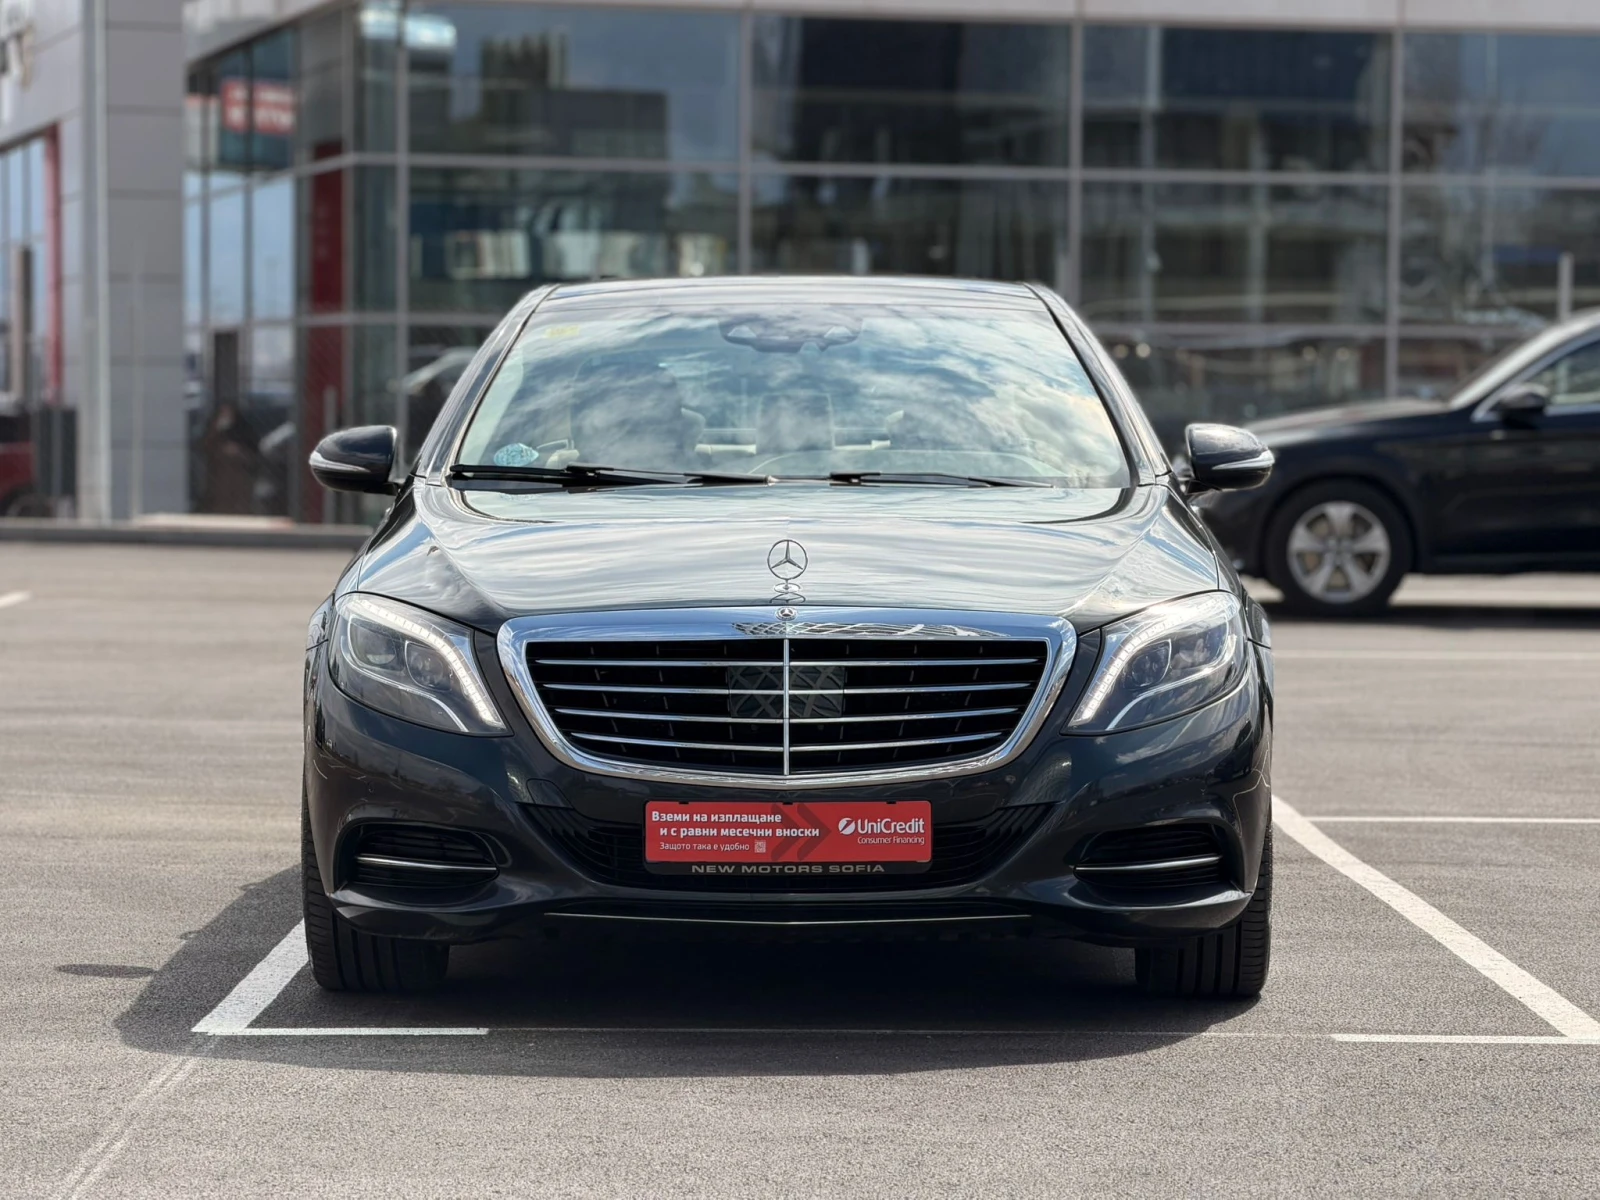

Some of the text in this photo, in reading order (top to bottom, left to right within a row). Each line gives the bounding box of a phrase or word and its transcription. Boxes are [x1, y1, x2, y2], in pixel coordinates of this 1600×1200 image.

[651, 811, 782, 825] Вземи на изплащане
[857, 817, 925, 834] UniCredit
[659, 827, 820, 838] и с равни месечни вноски
[857, 836, 925, 846] Consumer Financing
[660, 842, 691, 851] Защото
[720, 842, 750, 851] удобно
[691, 864, 885, 873] NEW MOTORS SOFIA
